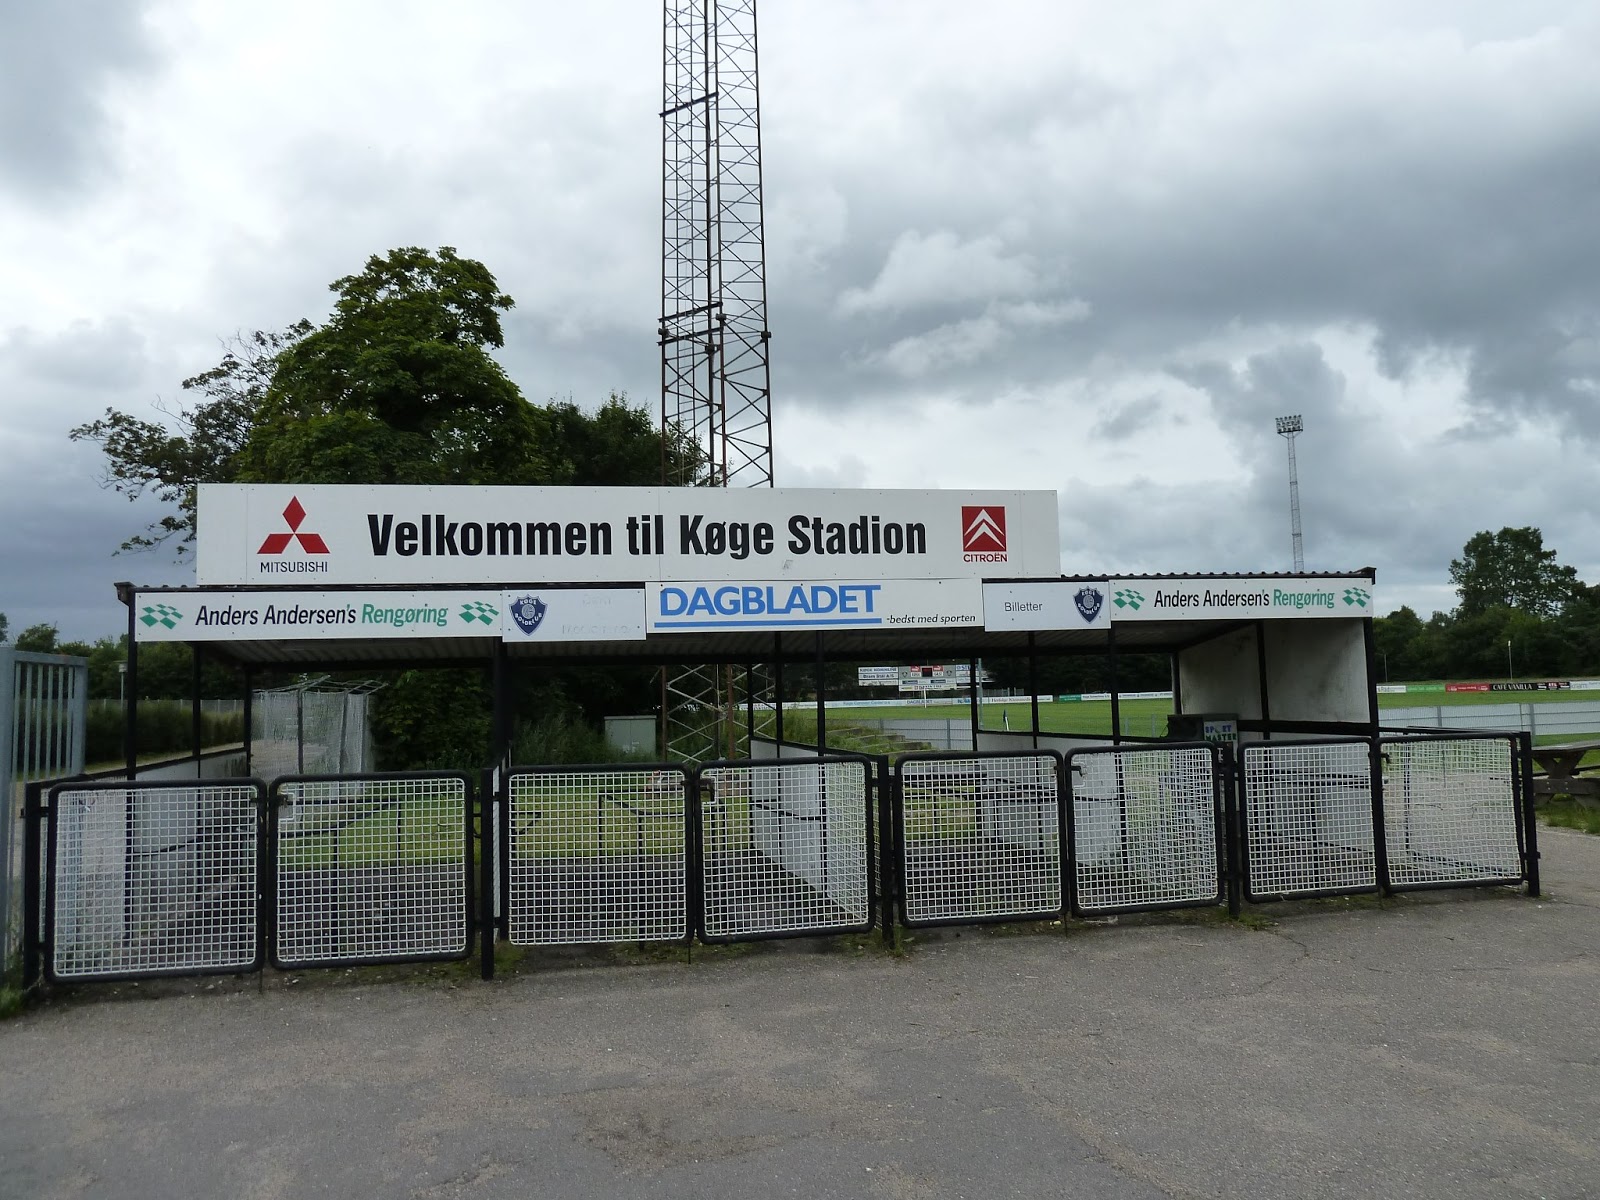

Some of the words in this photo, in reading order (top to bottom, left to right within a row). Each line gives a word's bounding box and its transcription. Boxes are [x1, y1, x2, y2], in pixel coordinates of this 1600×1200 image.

[367, 513, 613, 556] Velkommen
[626, 514, 664, 555] til
[680, 514, 775, 560] Køge
[787, 514, 927, 555] Stadion
[963, 552, 1008, 563] CITROËN
[260, 561, 328, 573] MITSUBISHI
[660, 584, 882, 616] DAGBLADET
[1004, 601, 1043, 612] Billetter
[1153, 590, 1199, 608] Anders
[1203, 589, 1270, 607] Andersen's
[1273, 588, 1335, 609] Rengøring
[195, 604, 259, 626] Anders
[263, 603, 356, 626] Andersen's
[361, 602, 449, 628] Rengøring
[917, 613, 939, 623] med
[940, 614, 976, 625] sporten
